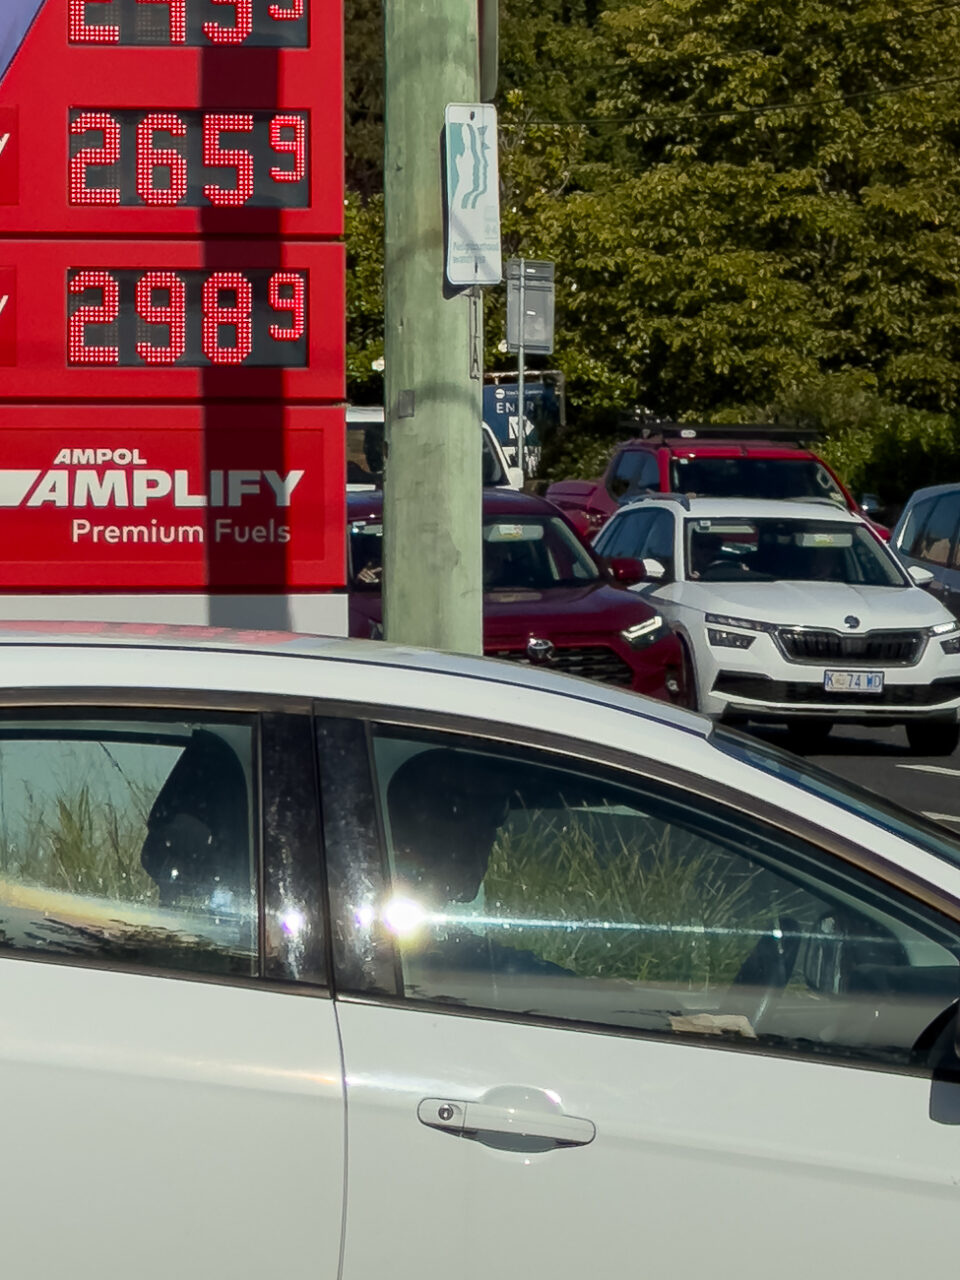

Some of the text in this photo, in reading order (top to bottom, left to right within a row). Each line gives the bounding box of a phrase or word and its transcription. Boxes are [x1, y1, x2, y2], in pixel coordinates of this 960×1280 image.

[496, 401, 534, 414] ENR
[53, 448, 147, 465] AMPOL
[27, 470, 304, 507] AMPLIFY
[72, 519, 291, 544] Premium Fuels
